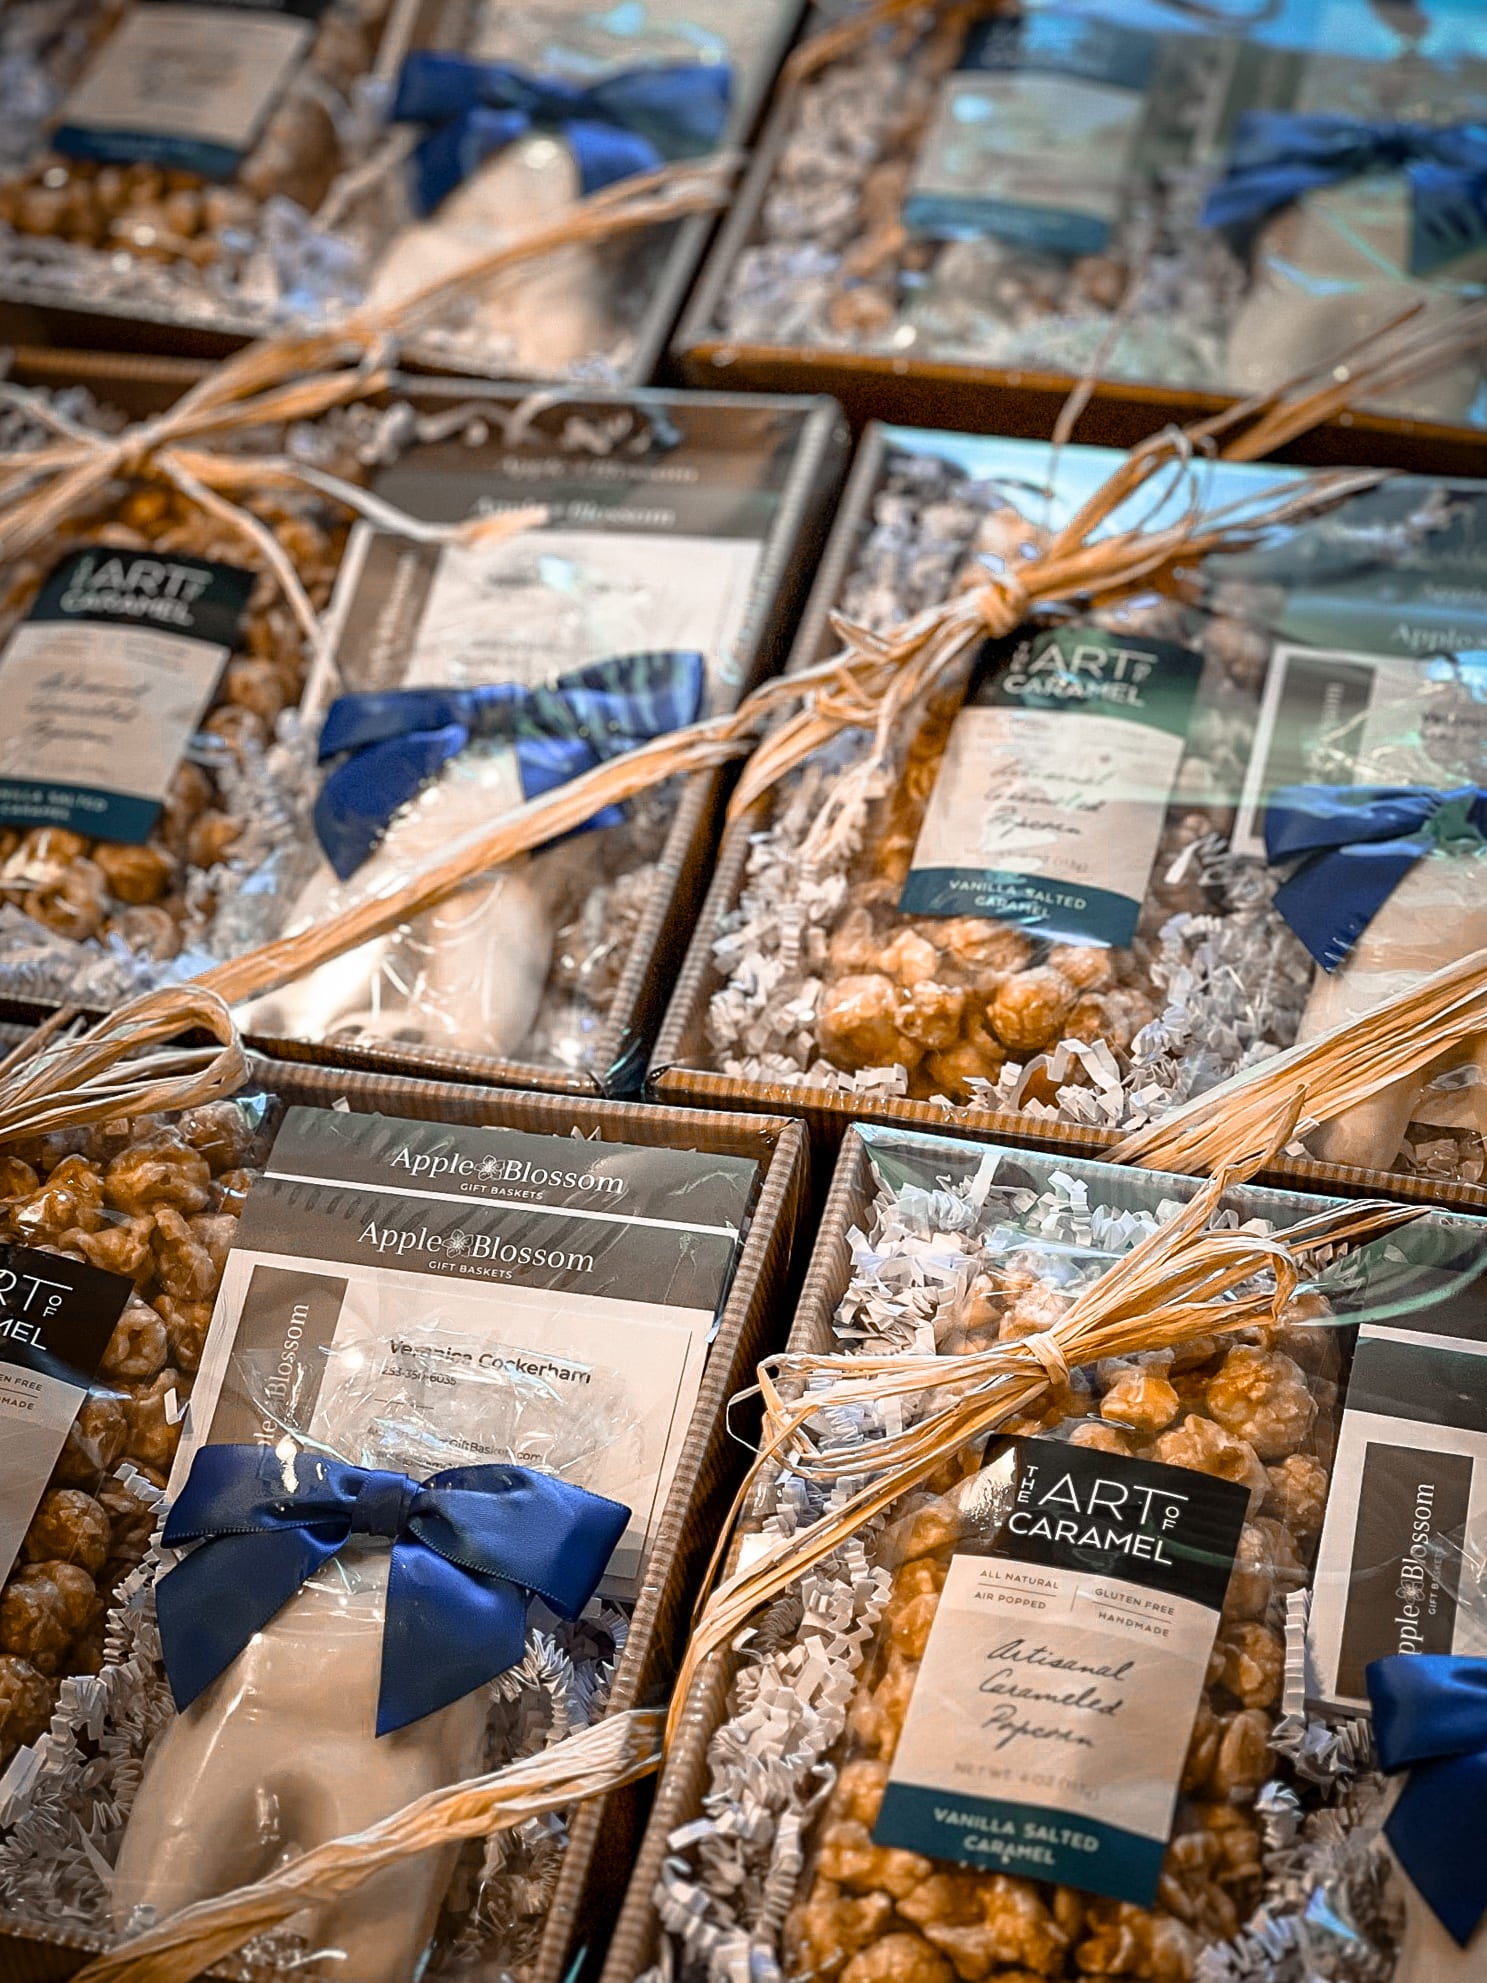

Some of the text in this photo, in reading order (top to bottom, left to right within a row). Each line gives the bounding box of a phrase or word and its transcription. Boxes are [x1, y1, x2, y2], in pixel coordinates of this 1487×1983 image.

[91, 557, 214, 597] ART
[1027, 643, 1159, 681] ART
[949, 879, 1017, 896] VANILLA
[390, 1147, 625, 1195] Apple Blossom
[460, 1182, 544, 1200] GIFT BASKETS
[357, 1221, 595, 1273] Apple Blossom
[428, 1260, 513, 1280] GIFT BASKETS
[0, 1269, 74, 1312] RT
[267, 1304, 310, 1401] Blossom
[0, 1397, 35, 1410] MADE
[14, 1378, 43, 1392] FREE
[1017, 1465, 1189, 1530] THE ART OF
[1008, 1512, 1173, 1565] CARAMEL
[980, 1569, 1059, 1589] ALL NATURAL
[1395, 1483, 1436, 1655] pple Blossom
[974, 1591, 1046, 1610] AIR POPPED
[1095, 1588, 1175, 1616] GLUTEN FREE
[1428, 1592, 1439, 1615] GIFT
[1098, 1611, 1170, 1637] HANDMADE
[986, 1638, 1136, 1682] Artisanal
[979, 1667, 1124, 1717] Carameled
[981, 1703, 1094, 1750] Popcorn
[933, 1807, 1099, 1853] VANILLA SALTED
[963, 1834, 1056, 1866] CARAMEL
